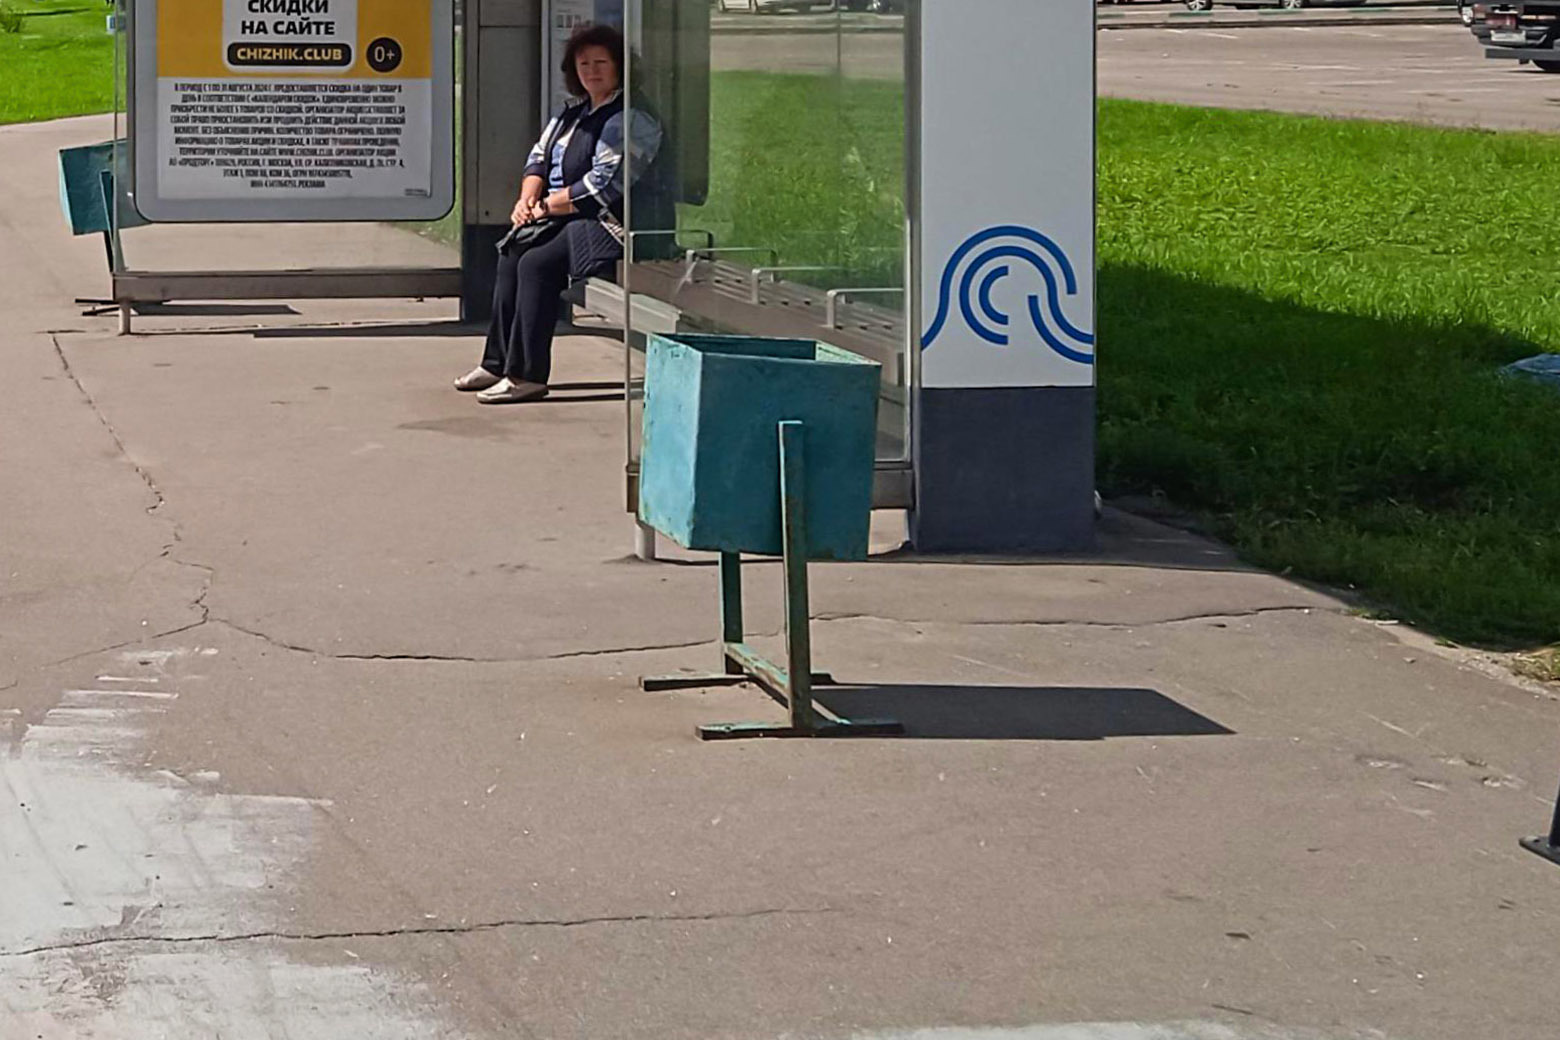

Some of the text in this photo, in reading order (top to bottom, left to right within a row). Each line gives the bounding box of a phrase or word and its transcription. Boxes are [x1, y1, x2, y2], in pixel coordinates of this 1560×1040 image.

[247, 0, 329, 16] СКИДКИ
[241, 17, 335, 36] НА САЙТЕ
[236, 47, 343, 61] CHIZHIK.CLUB
[373, 46, 396, 63] 0+
